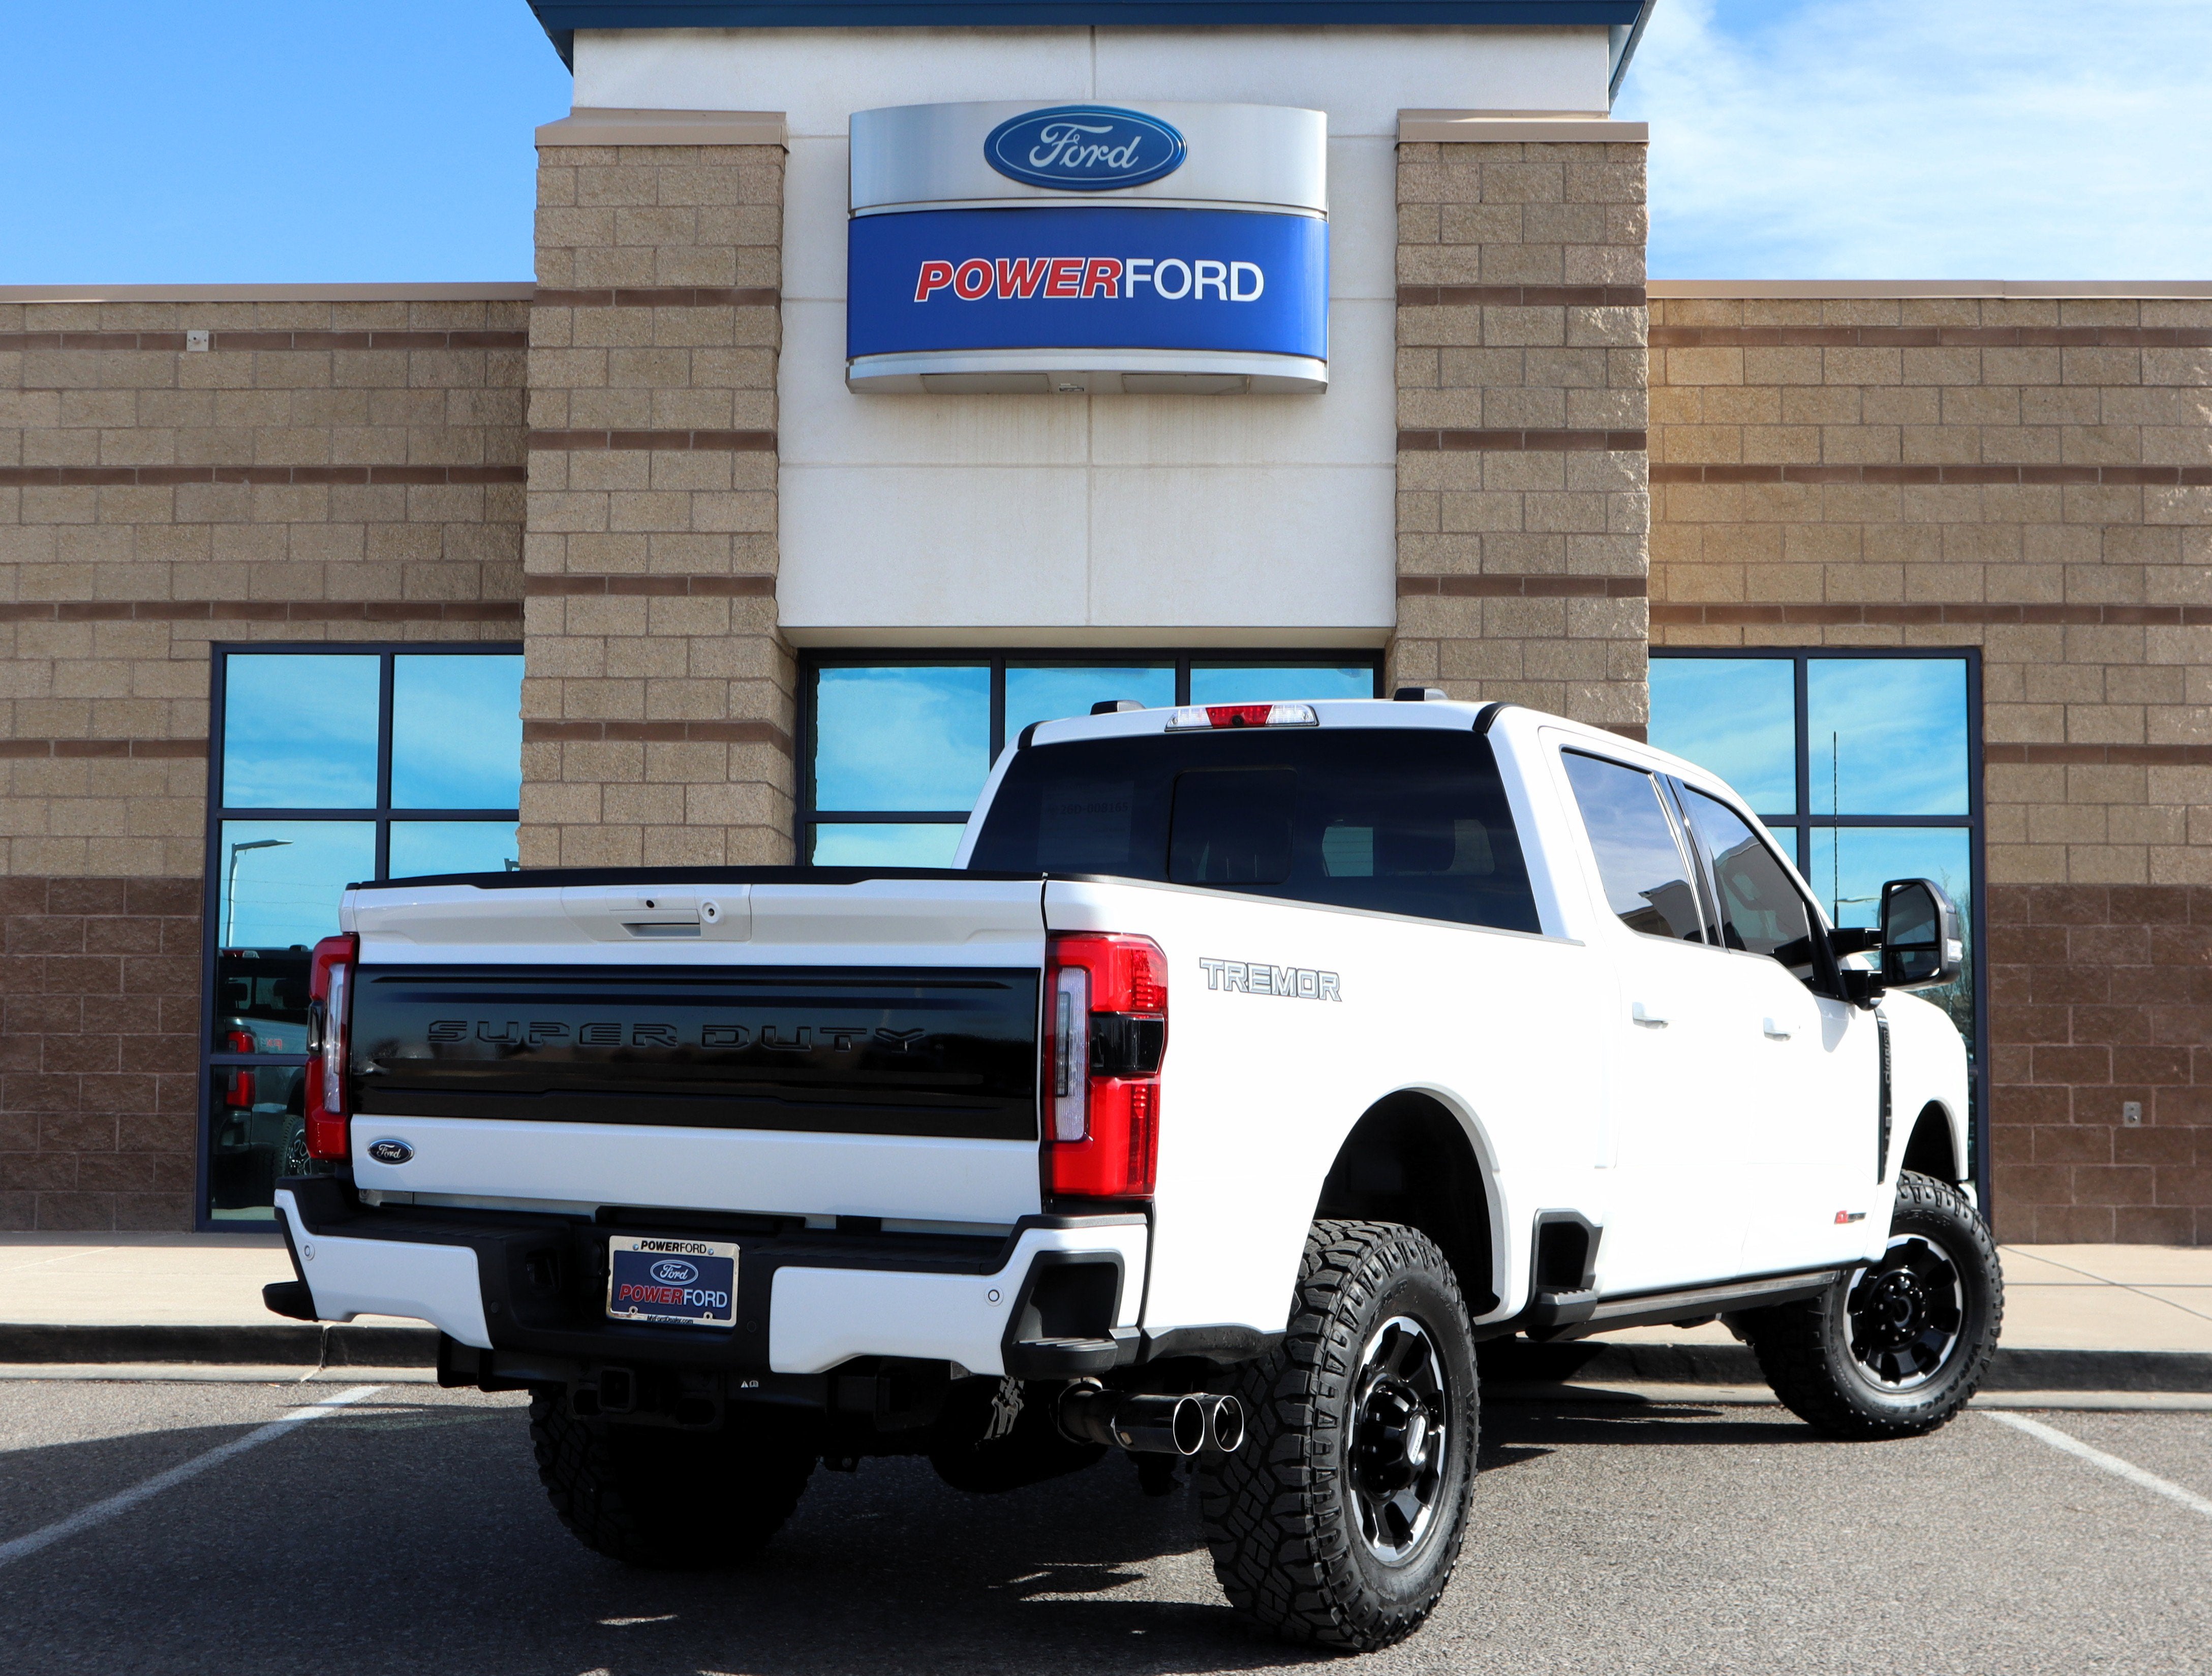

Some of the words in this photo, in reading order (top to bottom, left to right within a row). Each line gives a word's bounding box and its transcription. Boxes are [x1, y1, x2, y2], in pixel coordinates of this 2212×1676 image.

[1029, 122, 1142, 169] Ford
[1199, 957, 1342, 1002] TREMOR
[428, 1020, 678, 1049] SUPER
[701, 1024, 926, 1054] DUTY
[377, 1143, 402, 1159] Ford
[660, 1264, 689, 1280] Ford
[647, 1314, 694, 1324] MyFordDealer.com
